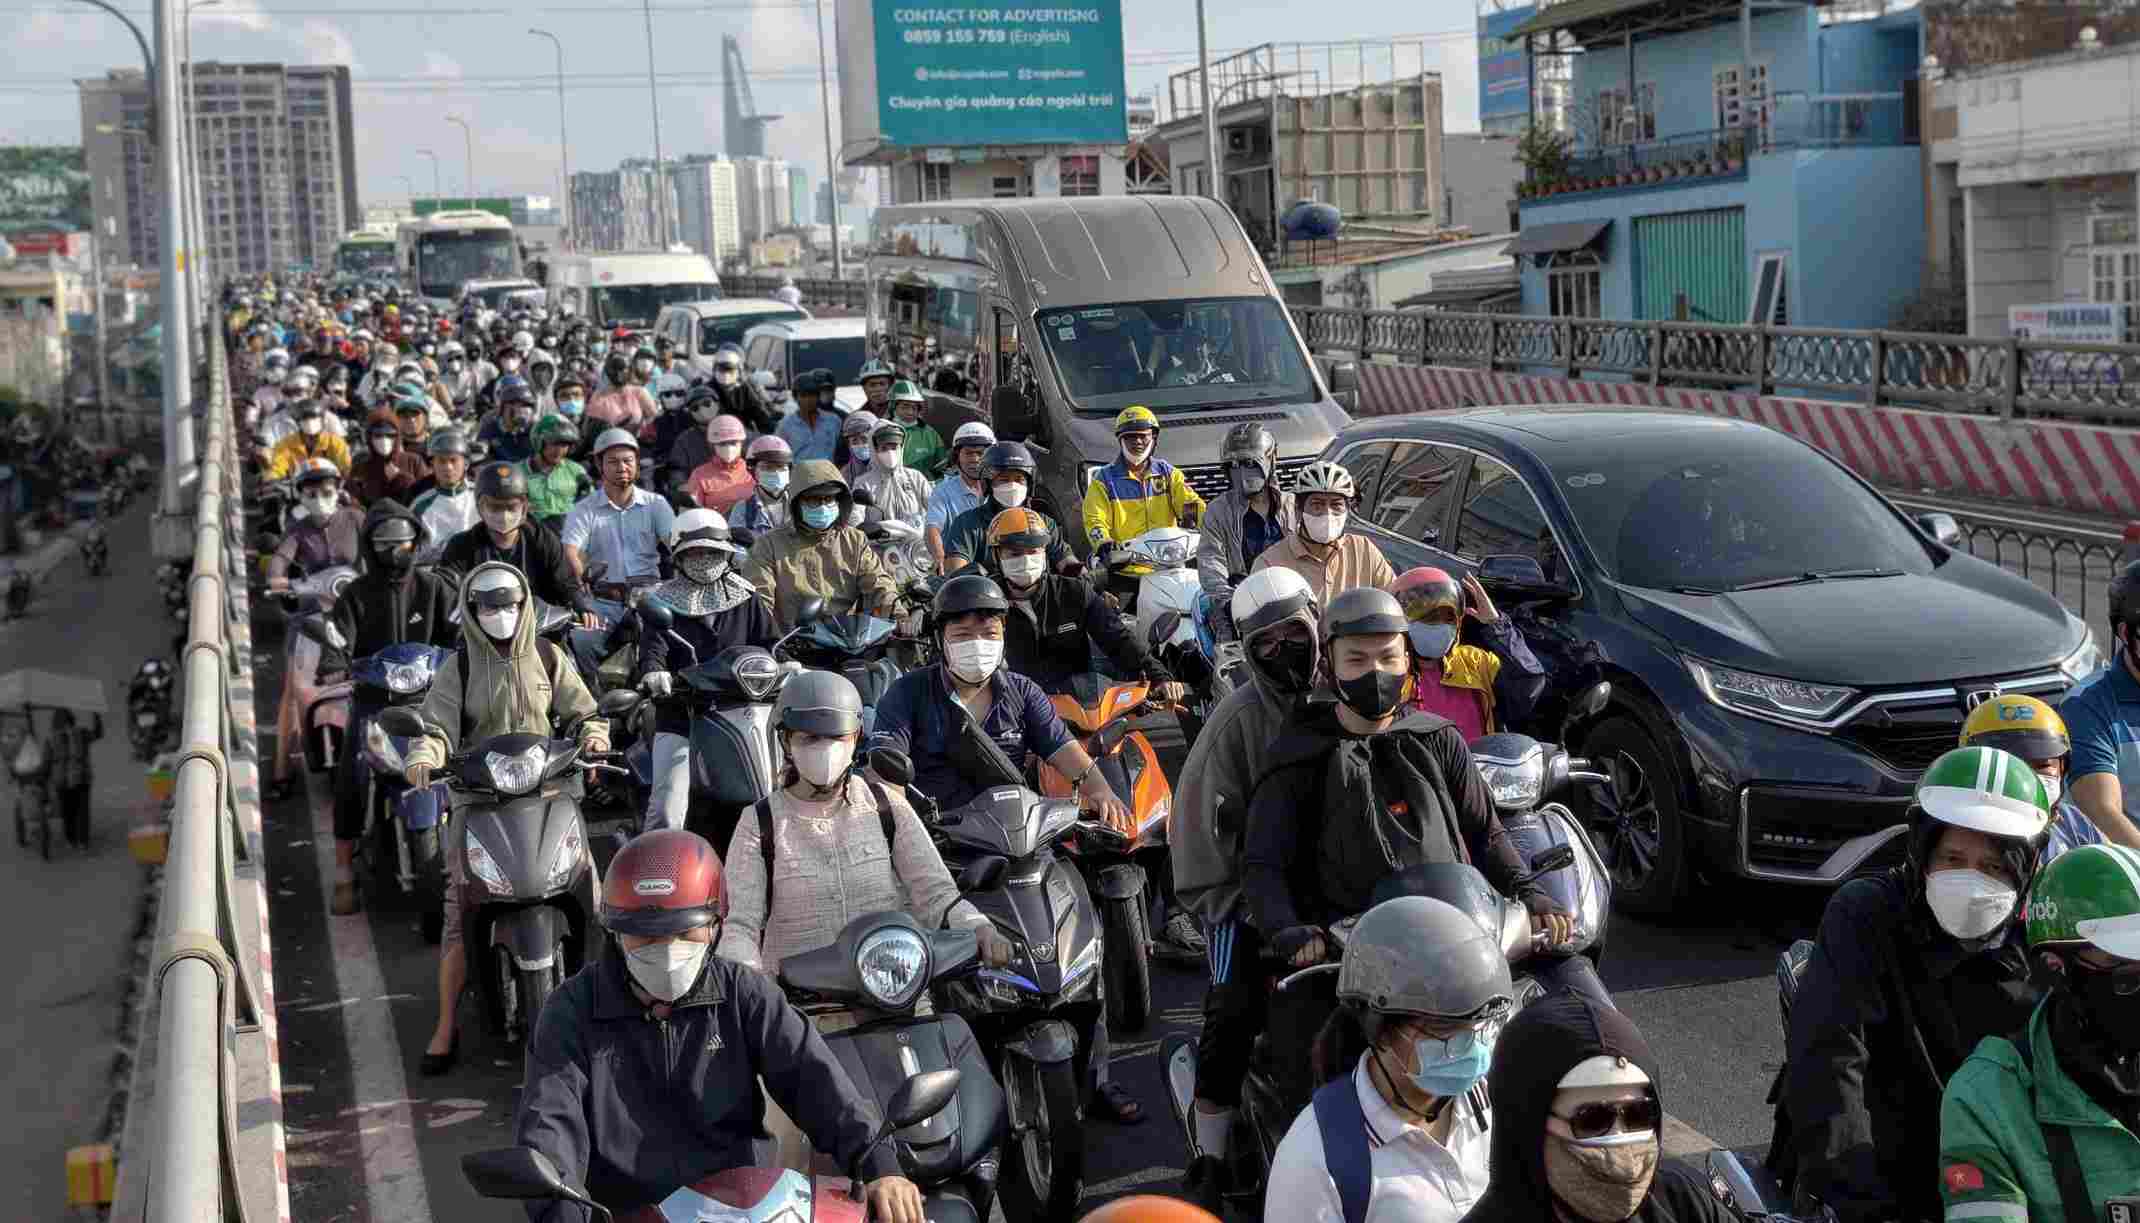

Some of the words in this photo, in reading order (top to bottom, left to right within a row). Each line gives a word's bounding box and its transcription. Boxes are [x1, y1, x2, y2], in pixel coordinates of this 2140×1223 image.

[894, 9, 964, 23] CONTACT
[970, 9, 1001, 23] FOR
[1006, 9, 1099, 23] ADVERTISNG
[1010, 29, 1071, 46] (English)
[888, 95, 942, 110] Chuyên
[945, 95, 967, 111] gia
[1019, 93, 1044, 108] cáo
